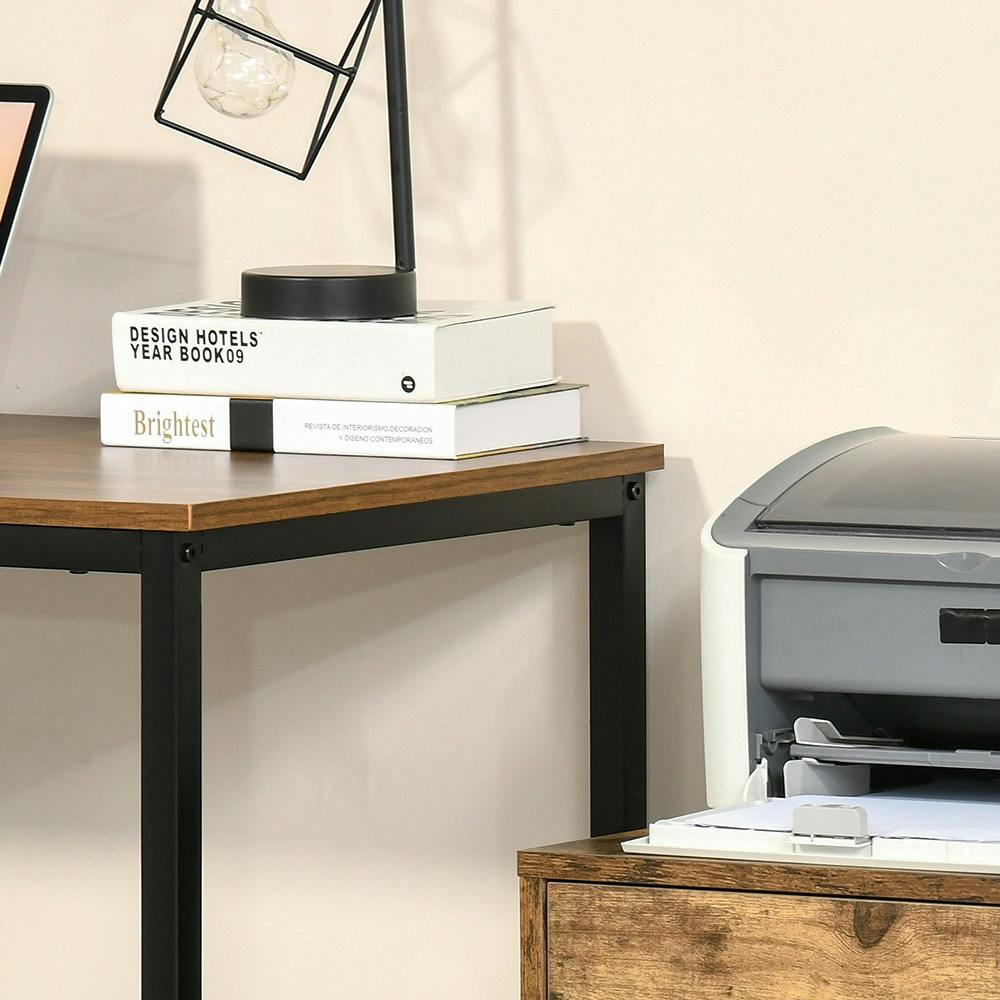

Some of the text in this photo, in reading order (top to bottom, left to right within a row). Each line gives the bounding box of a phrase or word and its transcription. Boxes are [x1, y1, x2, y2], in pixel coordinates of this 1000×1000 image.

[130, 326, 189, 344] DESIGN
[130, 343, 173, 361] YEAR
[134, 409, 215, 444] Brightest
[304, 422, 331, 431] REVISTA
[332, 423, 341, 431] DE
